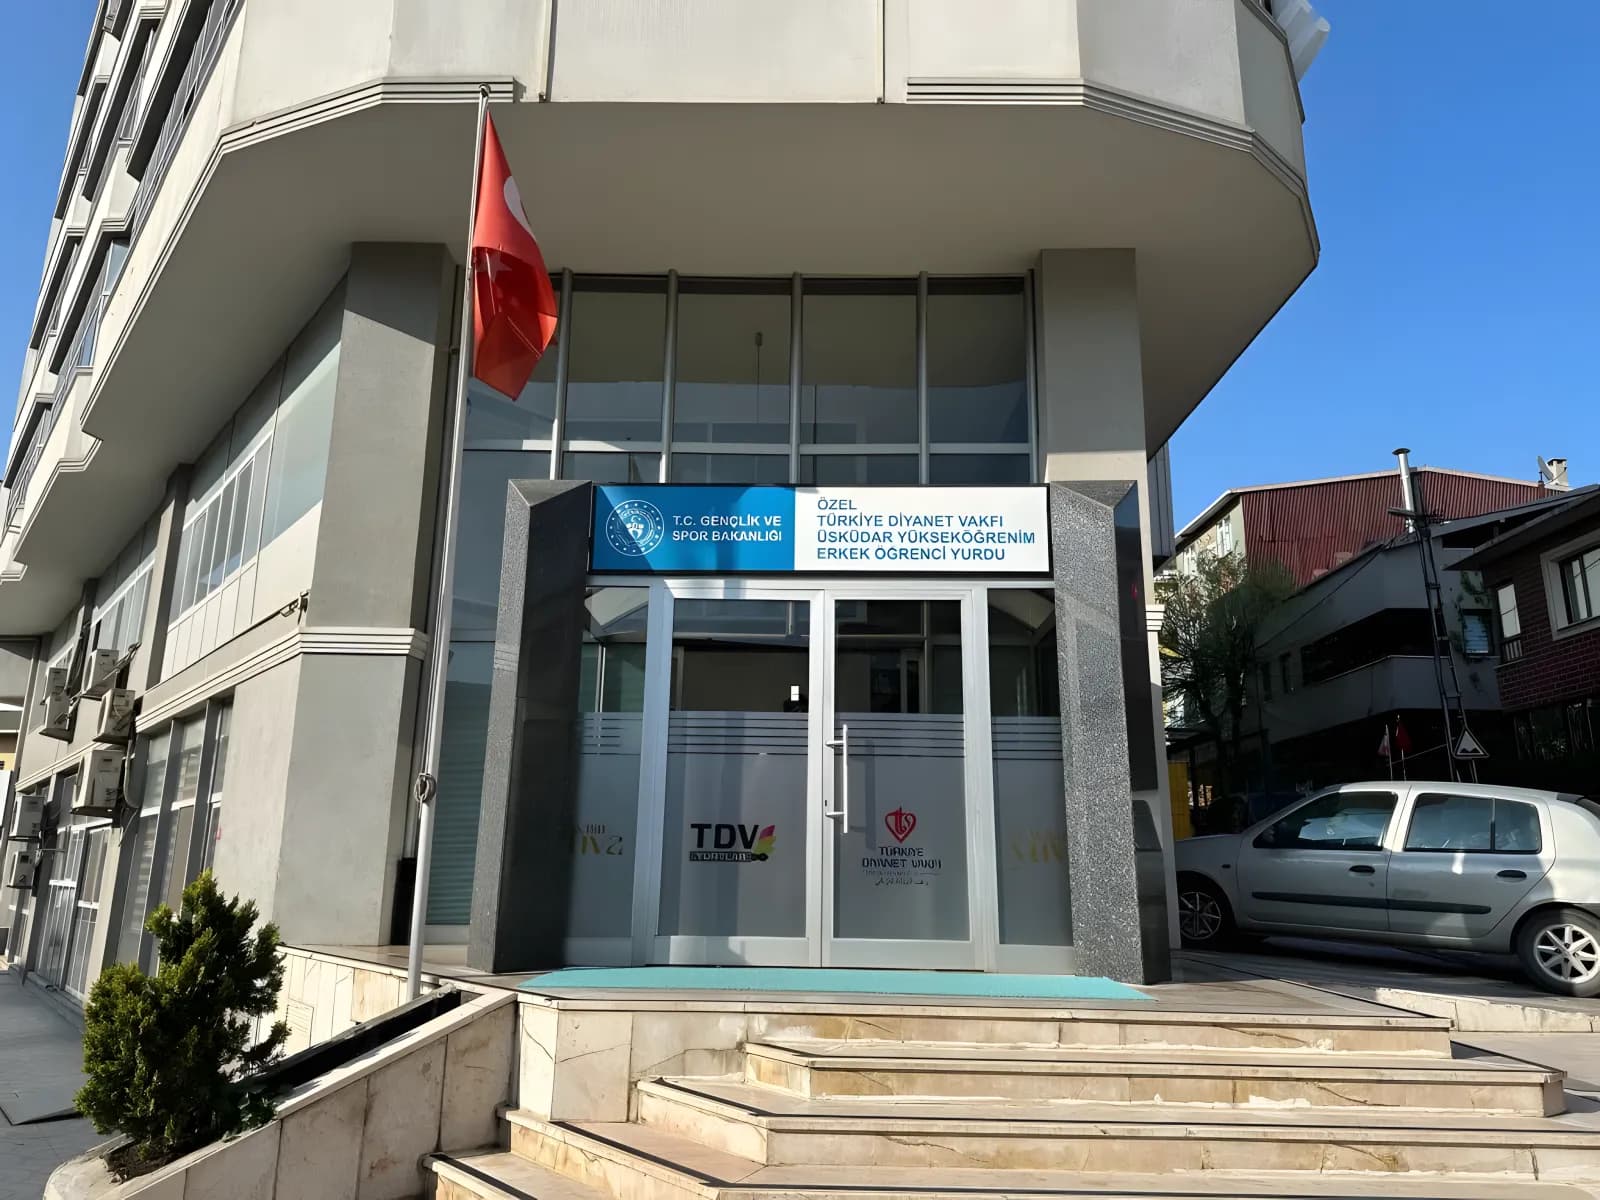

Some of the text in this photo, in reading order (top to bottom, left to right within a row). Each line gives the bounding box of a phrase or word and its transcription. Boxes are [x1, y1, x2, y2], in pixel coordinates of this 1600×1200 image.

[817, 496, 857, 510] ÖZEL
[672, 513, 782, 528] T.C. GENÇLİK VE
[816, 512, 1003, 527] TÜRKİYE DİYANET VAKFI
[672, 529, 782, 541] SPOR BAKANLIĞI
[817, 529, 1035, 544] ÜSKÜDAR YÜKSEKÖĞRENİM
[817, 545, 1005, 560] ERKEK ÖĞRENCİ YURDU
[690, 823, 759, 849] TDV
